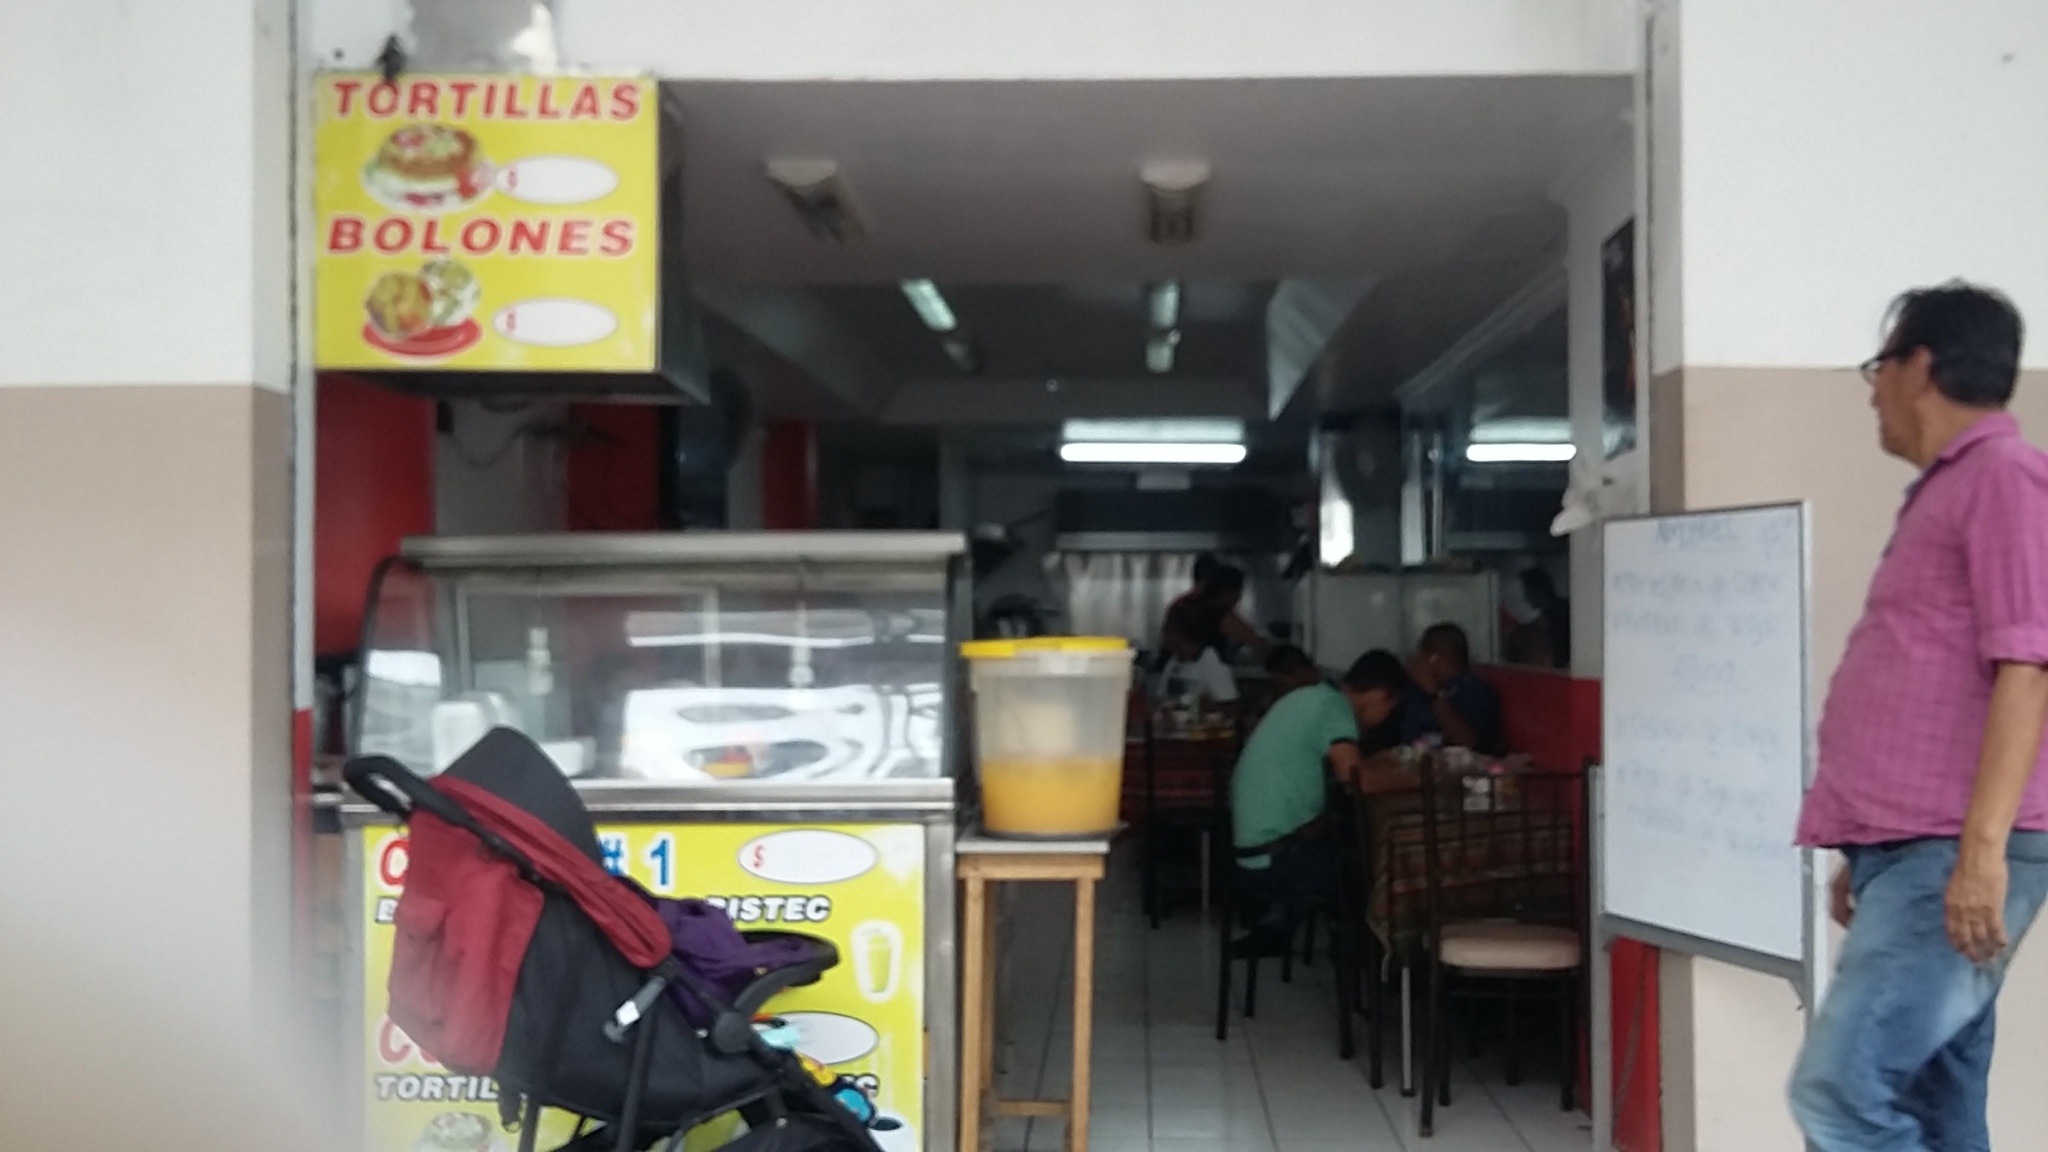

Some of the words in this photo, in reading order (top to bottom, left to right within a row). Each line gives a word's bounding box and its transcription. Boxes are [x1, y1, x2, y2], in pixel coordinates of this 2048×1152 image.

[333, 81, 640, 120] TORTILLAS
[327, 217, 635, 257] BOLONES
[650, 837, 671, 887] 1
[376, 1073, 500, 1101] TORTIL
